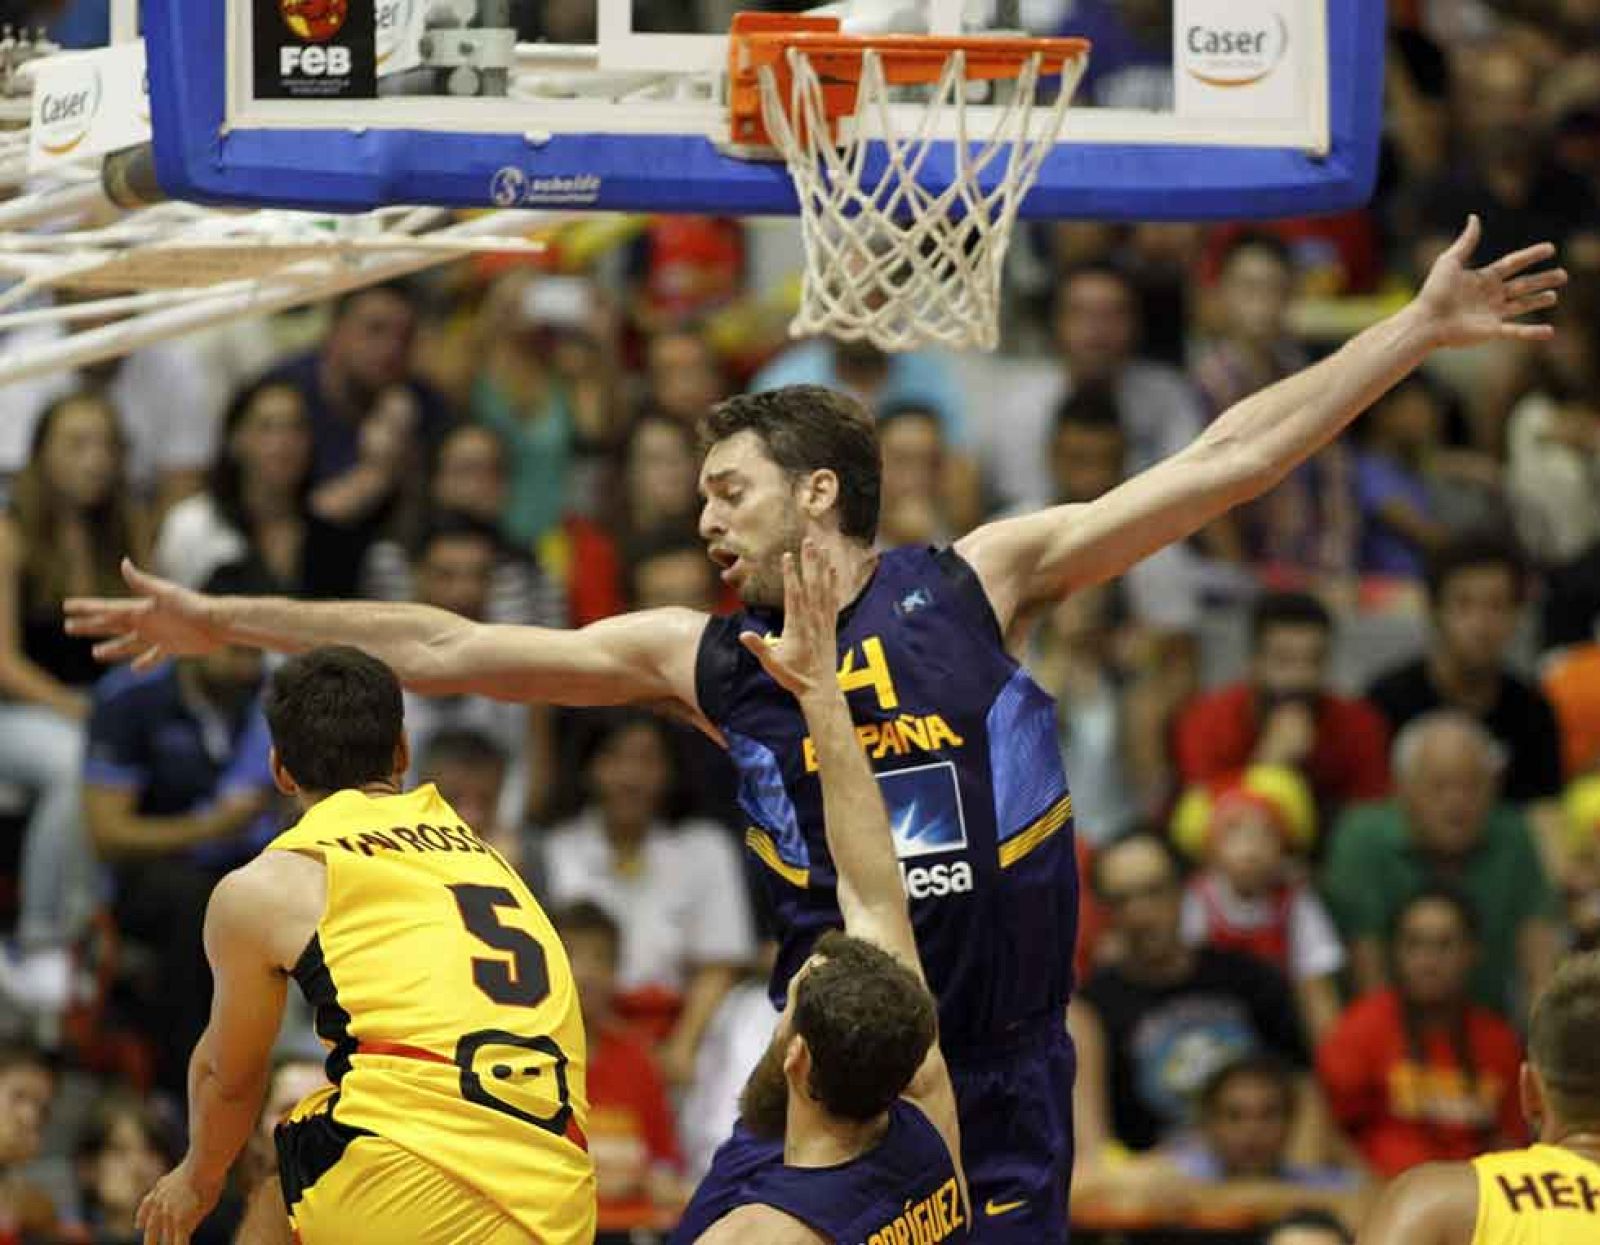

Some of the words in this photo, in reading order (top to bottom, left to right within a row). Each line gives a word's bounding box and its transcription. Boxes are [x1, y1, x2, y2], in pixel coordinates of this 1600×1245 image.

[1187, 25, 1267, 53] Caser
[41, 90, 88, 125] Caser
[803, 713, 963, 773] EPAÑA
[898, 860, 973, 898] esa
[445, 884, 551, 1008] 5
